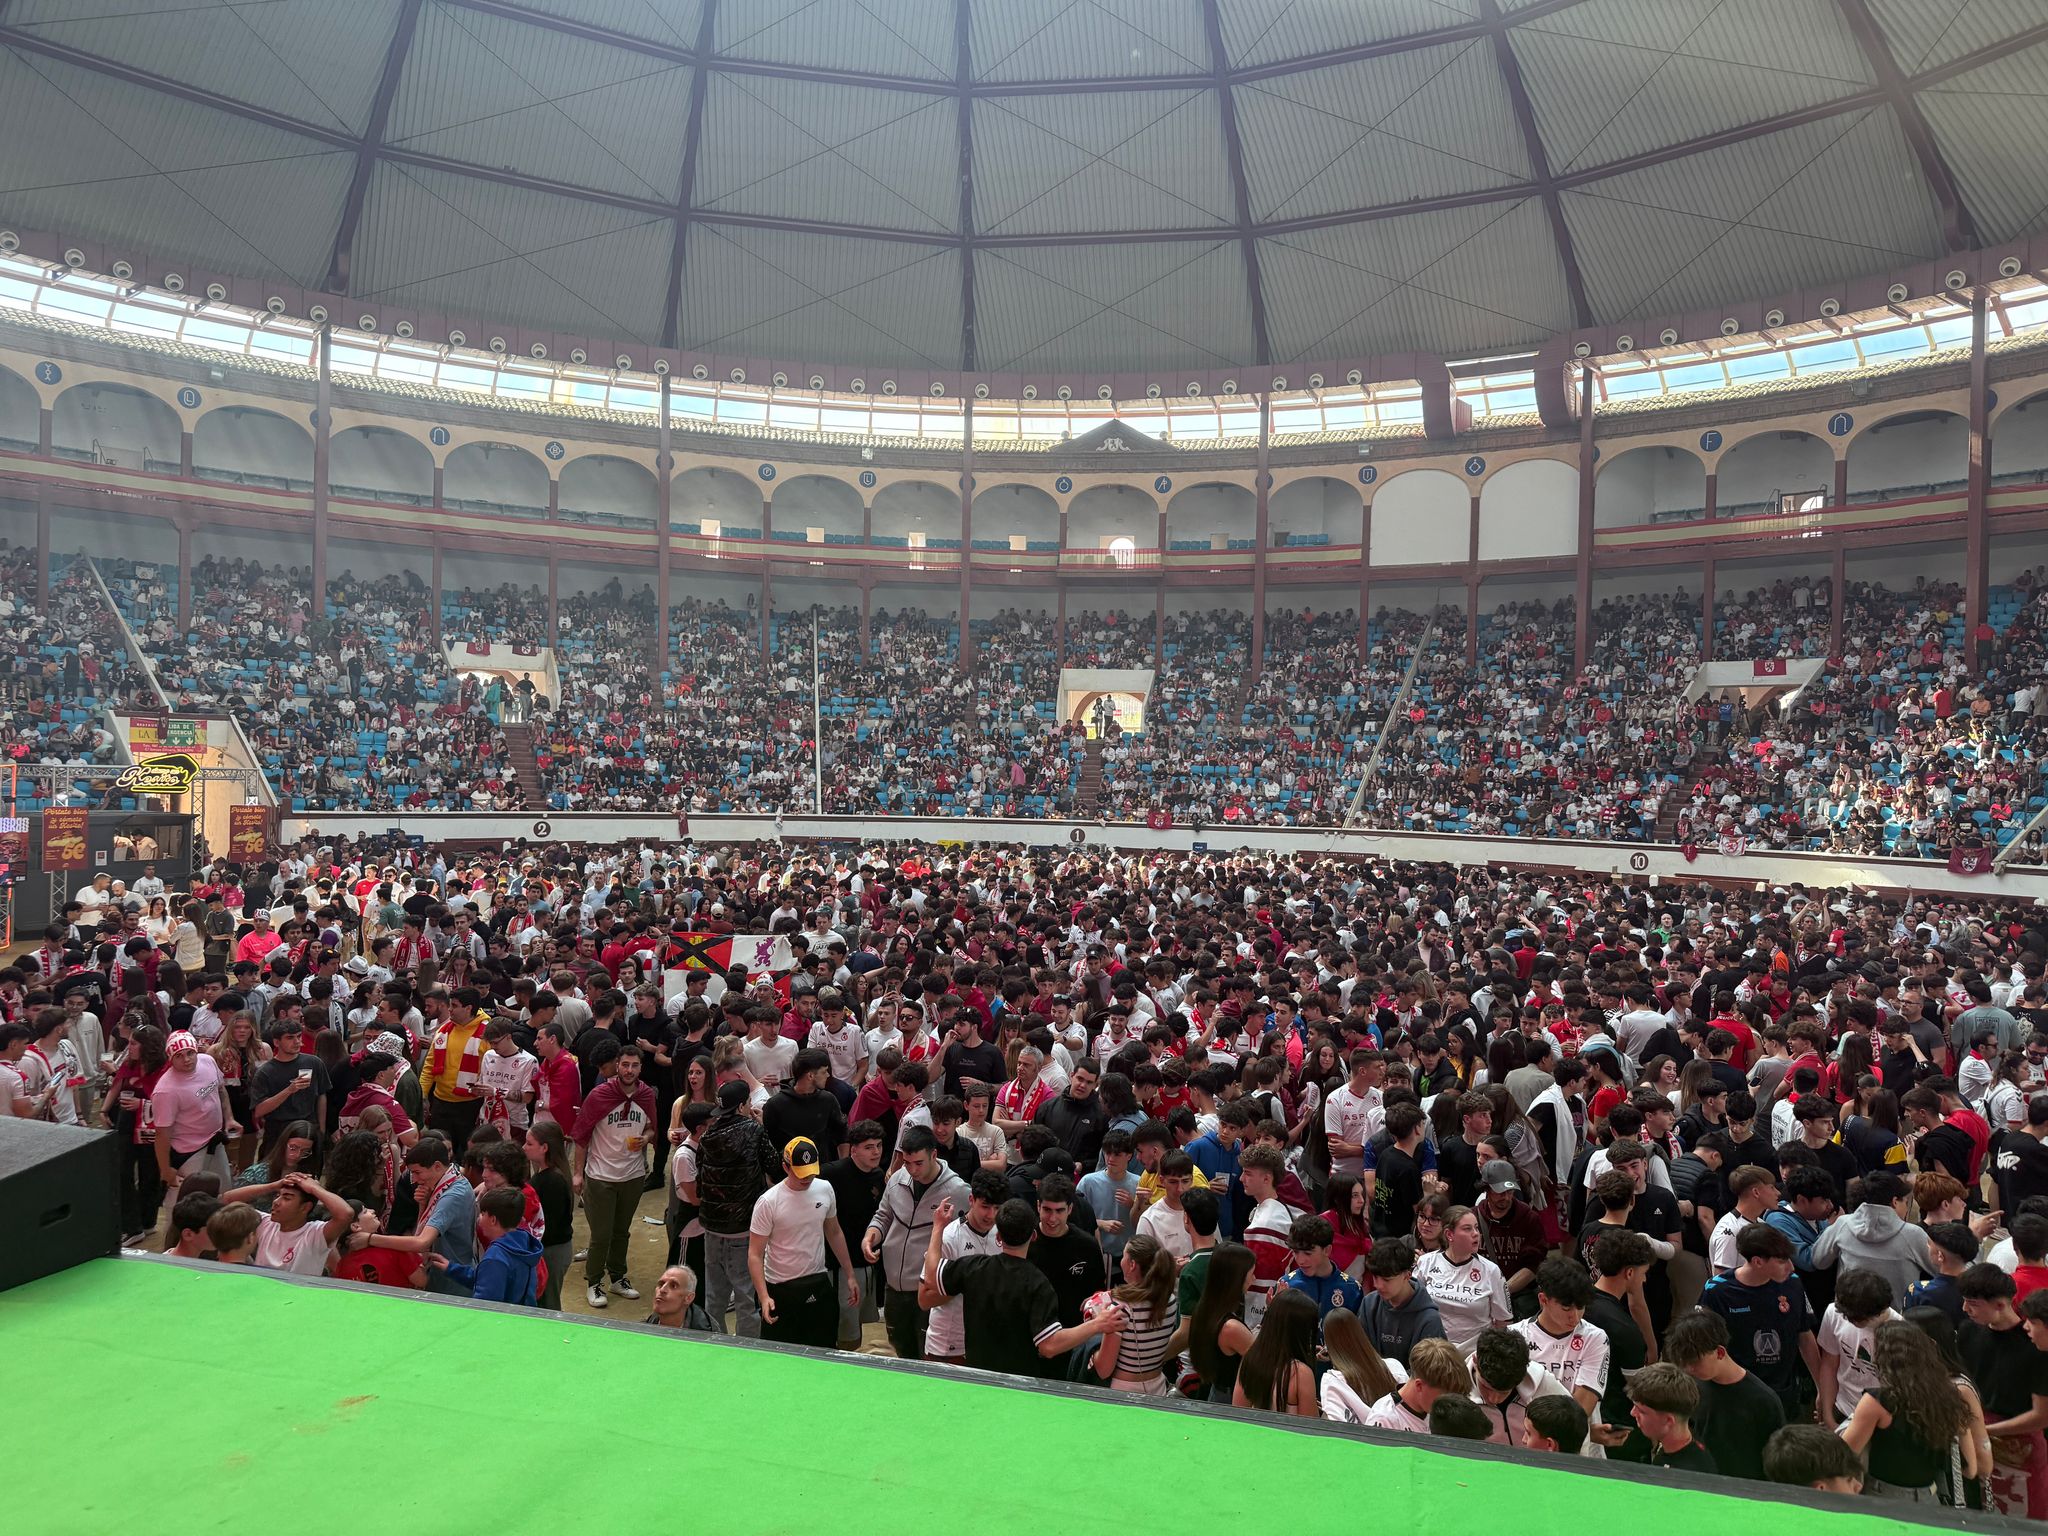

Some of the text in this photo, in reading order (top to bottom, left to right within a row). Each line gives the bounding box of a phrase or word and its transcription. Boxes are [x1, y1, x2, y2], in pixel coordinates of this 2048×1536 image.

[537, 823, 547, 836] 2
[1075, 831, 1081, 842] 1
[1632, 855, 1645, 869] 10
